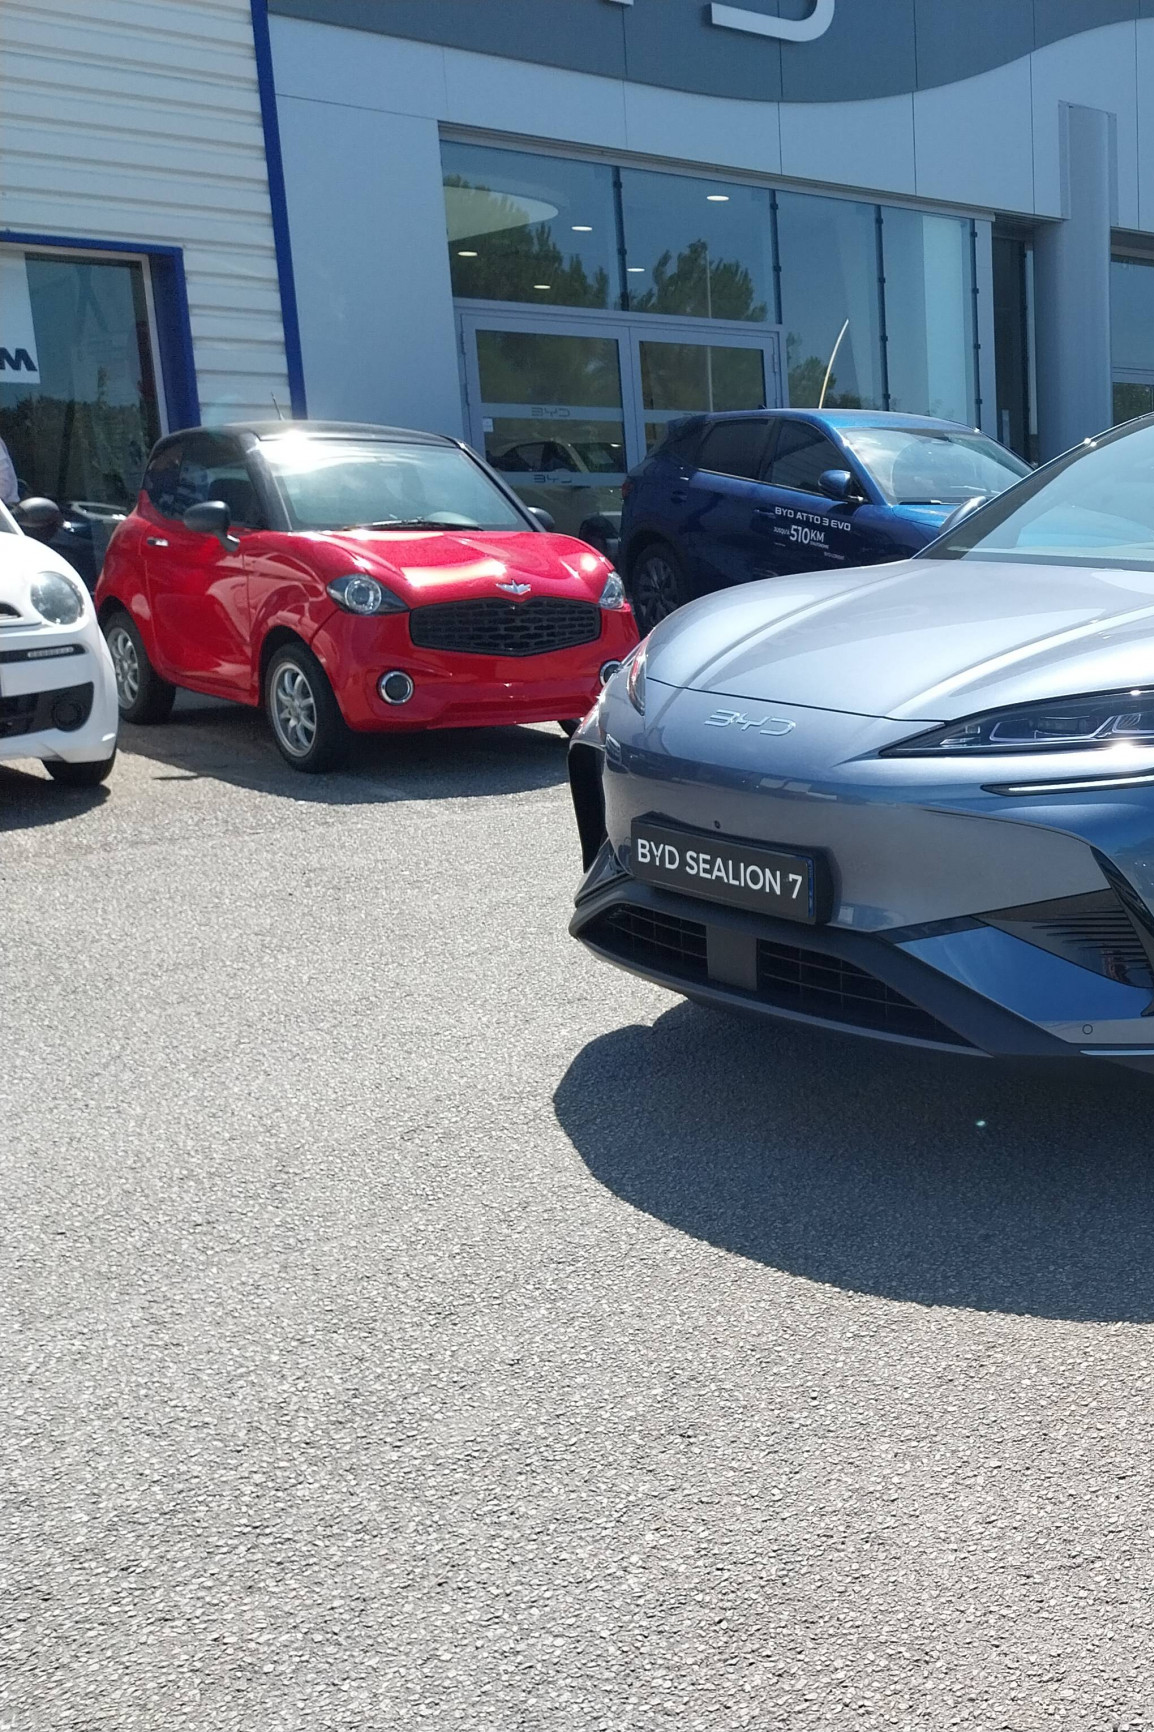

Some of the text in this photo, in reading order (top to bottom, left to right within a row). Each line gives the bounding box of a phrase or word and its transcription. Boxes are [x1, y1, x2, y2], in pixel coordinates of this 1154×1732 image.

[775, 506, 851, 531] BYD ATTO 3 EVO
[789, 525, 810, 544] 510
[810, 529, 825, 542] KM
[704, 709, 796, 736] BYD
[637, 838, 803, 899] BYD SEALION 7
